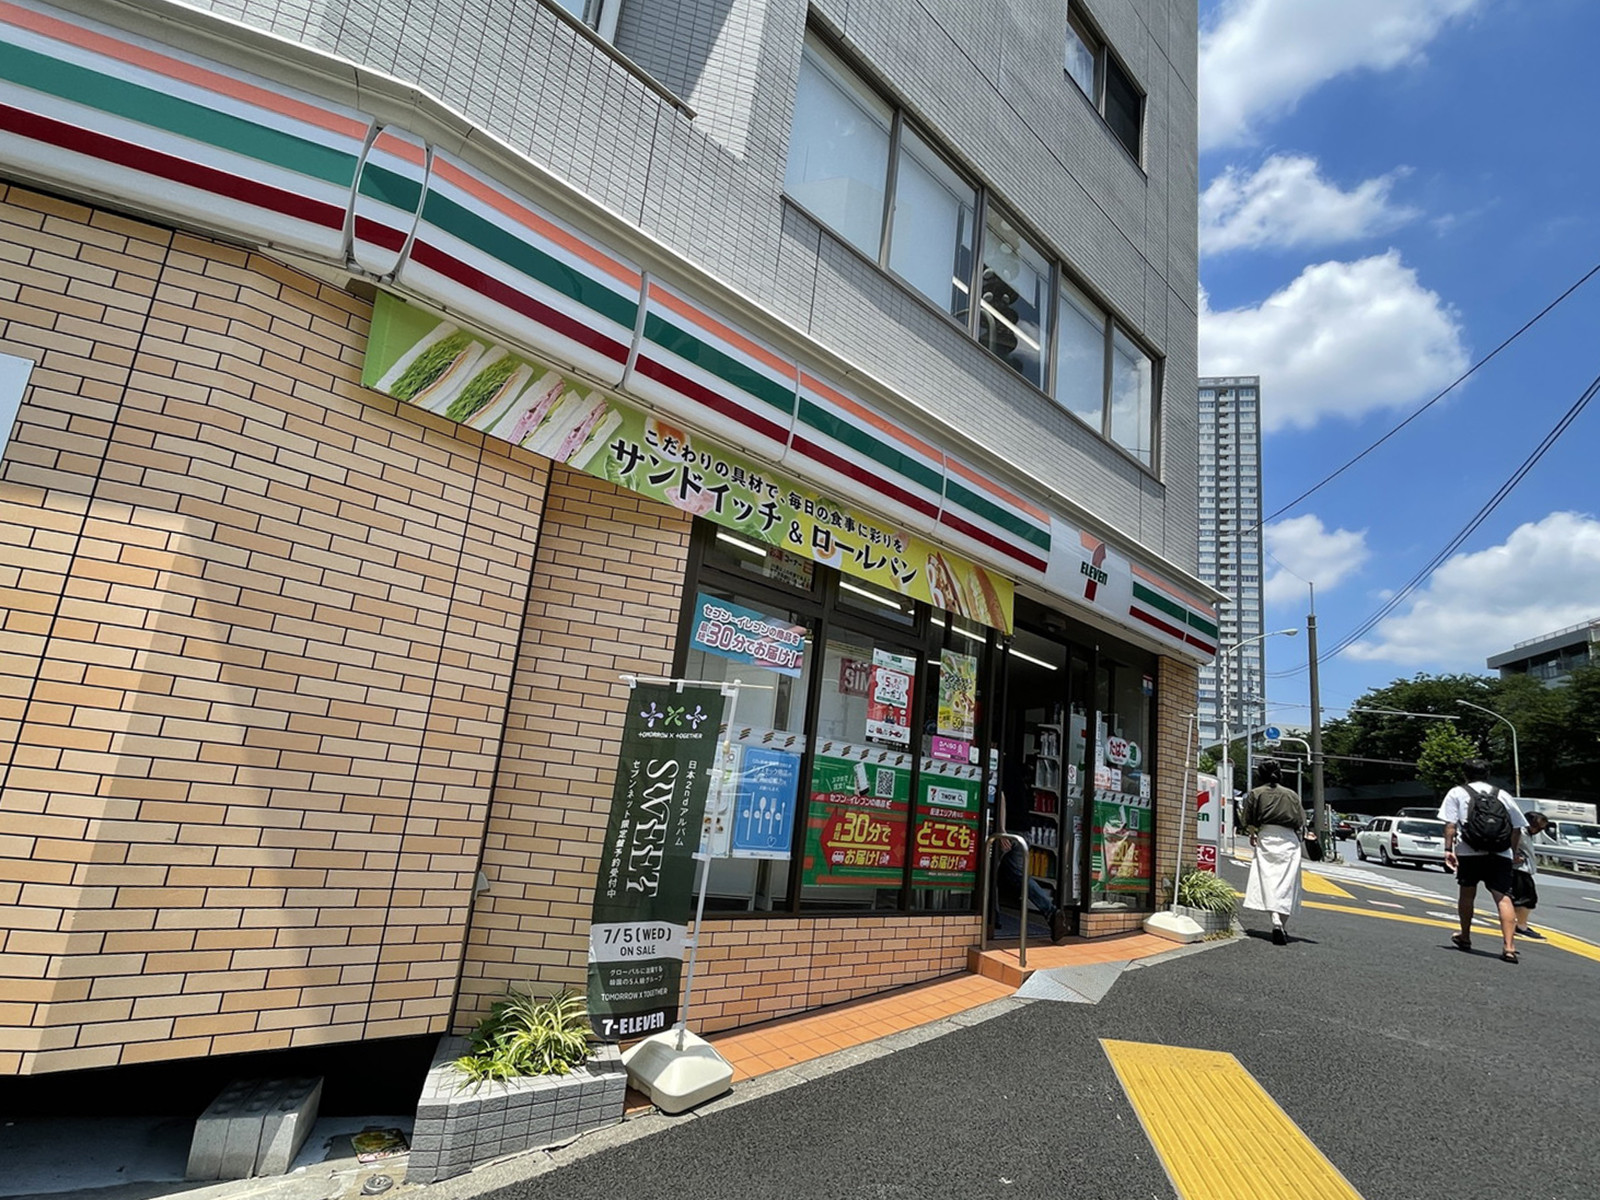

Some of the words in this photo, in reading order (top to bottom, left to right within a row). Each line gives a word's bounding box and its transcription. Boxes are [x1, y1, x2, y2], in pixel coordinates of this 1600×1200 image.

[610, 439, 782, 532] サンドイッチ
[788, 520, 803, 545] &
[812, 525, 918, 585] ロールパン
[916, 821, 971, 849] どこでも
[620, 946, 634, 957] ON
[636, 944, 656, 956] SALE
